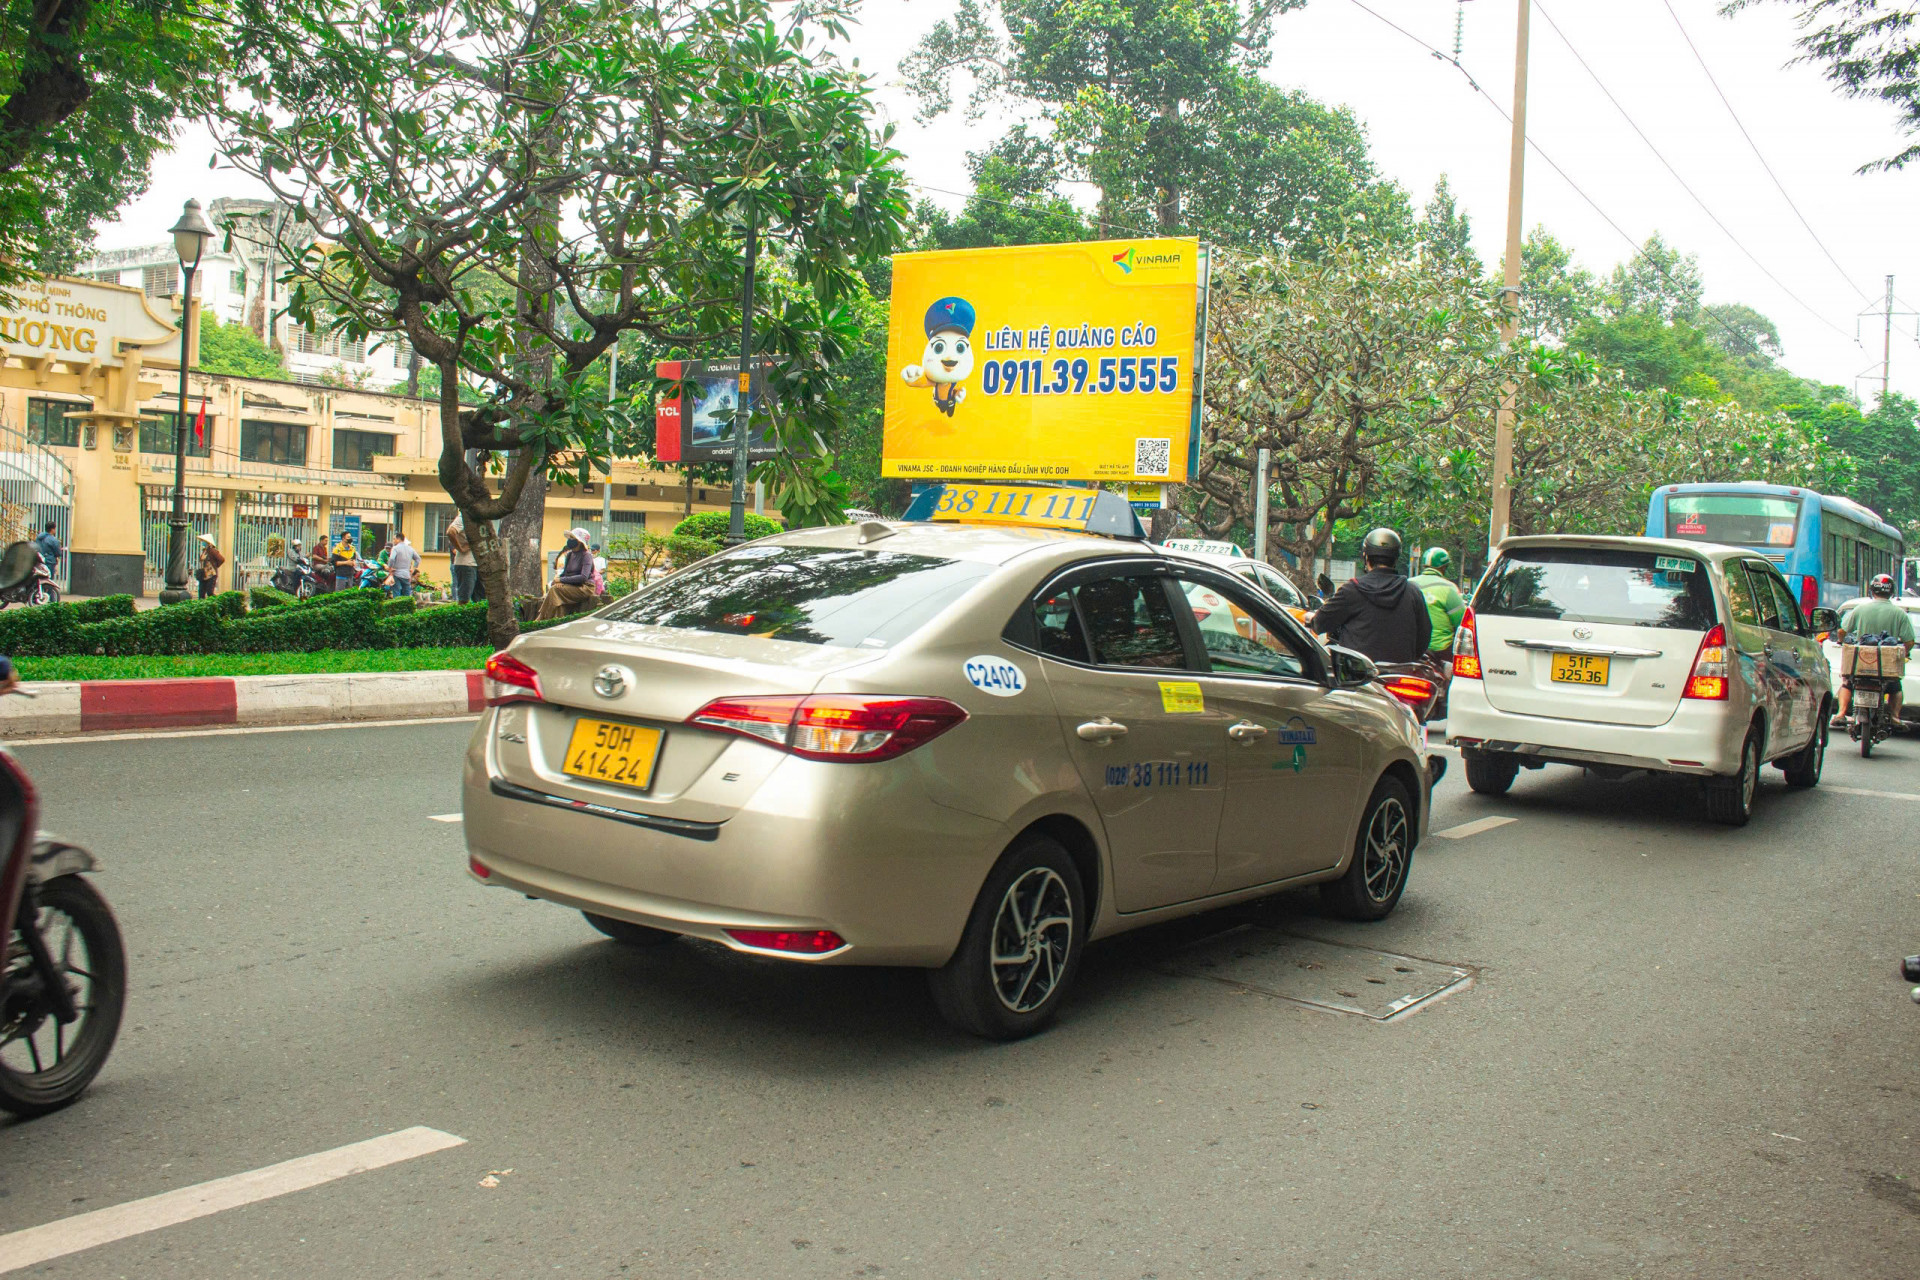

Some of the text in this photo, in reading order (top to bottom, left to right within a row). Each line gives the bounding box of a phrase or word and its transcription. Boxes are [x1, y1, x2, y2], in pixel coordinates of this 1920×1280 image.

[1136, 254, 1181, 265] VINAMA
[48, 287, 71, 298] MINH
[55, 303, 107, 322] THÔNG
[986, 322, 1156, 353] LIÊN HỆ QUẢNG CÁO
[983, 357, 1178, 395] 0911.39.5555
[658, 407, 679, 416] TCL
[897, 464, 921, 472] VINAMA
[922, 465, 934, 473] JSC
[940, 465, 962, 473] DOANH
[936, 489, 1095, 521] 38 111 111
[1568, 656, 1593, 668] 51F
[966, 663, 1022, 690] C2402
[1558, 668, 1602, 683] 325.36
[595, 724, 635, 752] 50H
[573, 750, 641, 783] 414.24
[1133, 762, 1152, 787] 38
[1158, 762, 1181, 786] 111
[1187, 761, 1209, 785] 111
[722, 772, 740, 782] E
